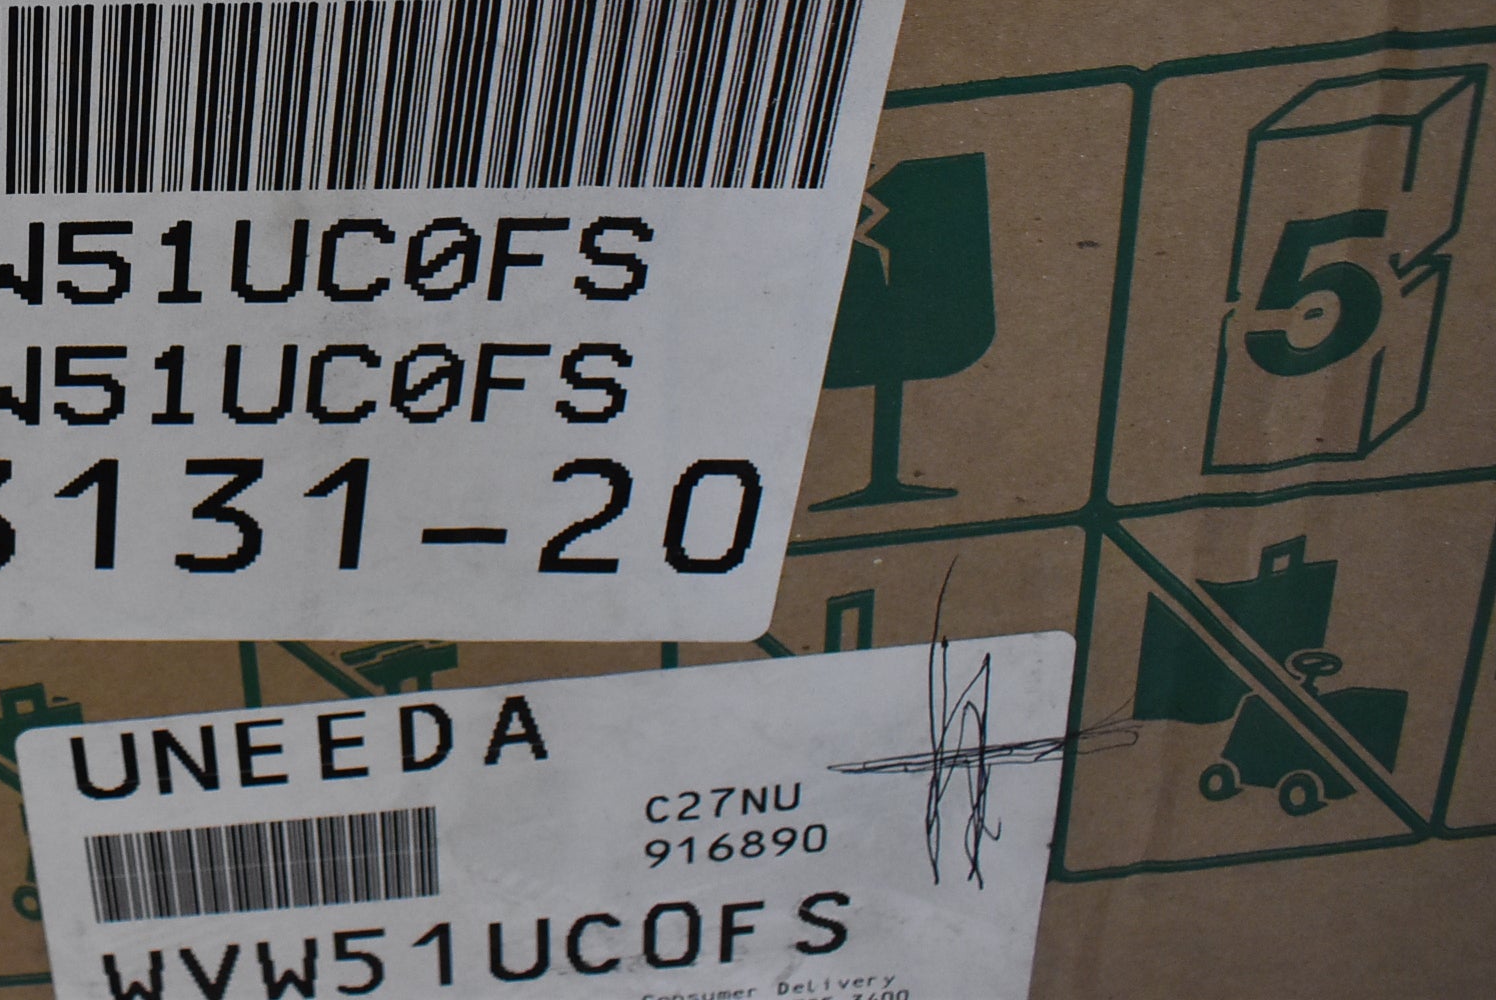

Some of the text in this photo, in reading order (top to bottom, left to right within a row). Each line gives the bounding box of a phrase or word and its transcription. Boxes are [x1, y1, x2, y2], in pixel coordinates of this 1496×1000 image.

[1244, 208, 1389, 377] 5
[69, 694, 549, 801] UNEEDA
[644, 781, 802, 825] C27NU
[643, 822, 829, 870] 916890
